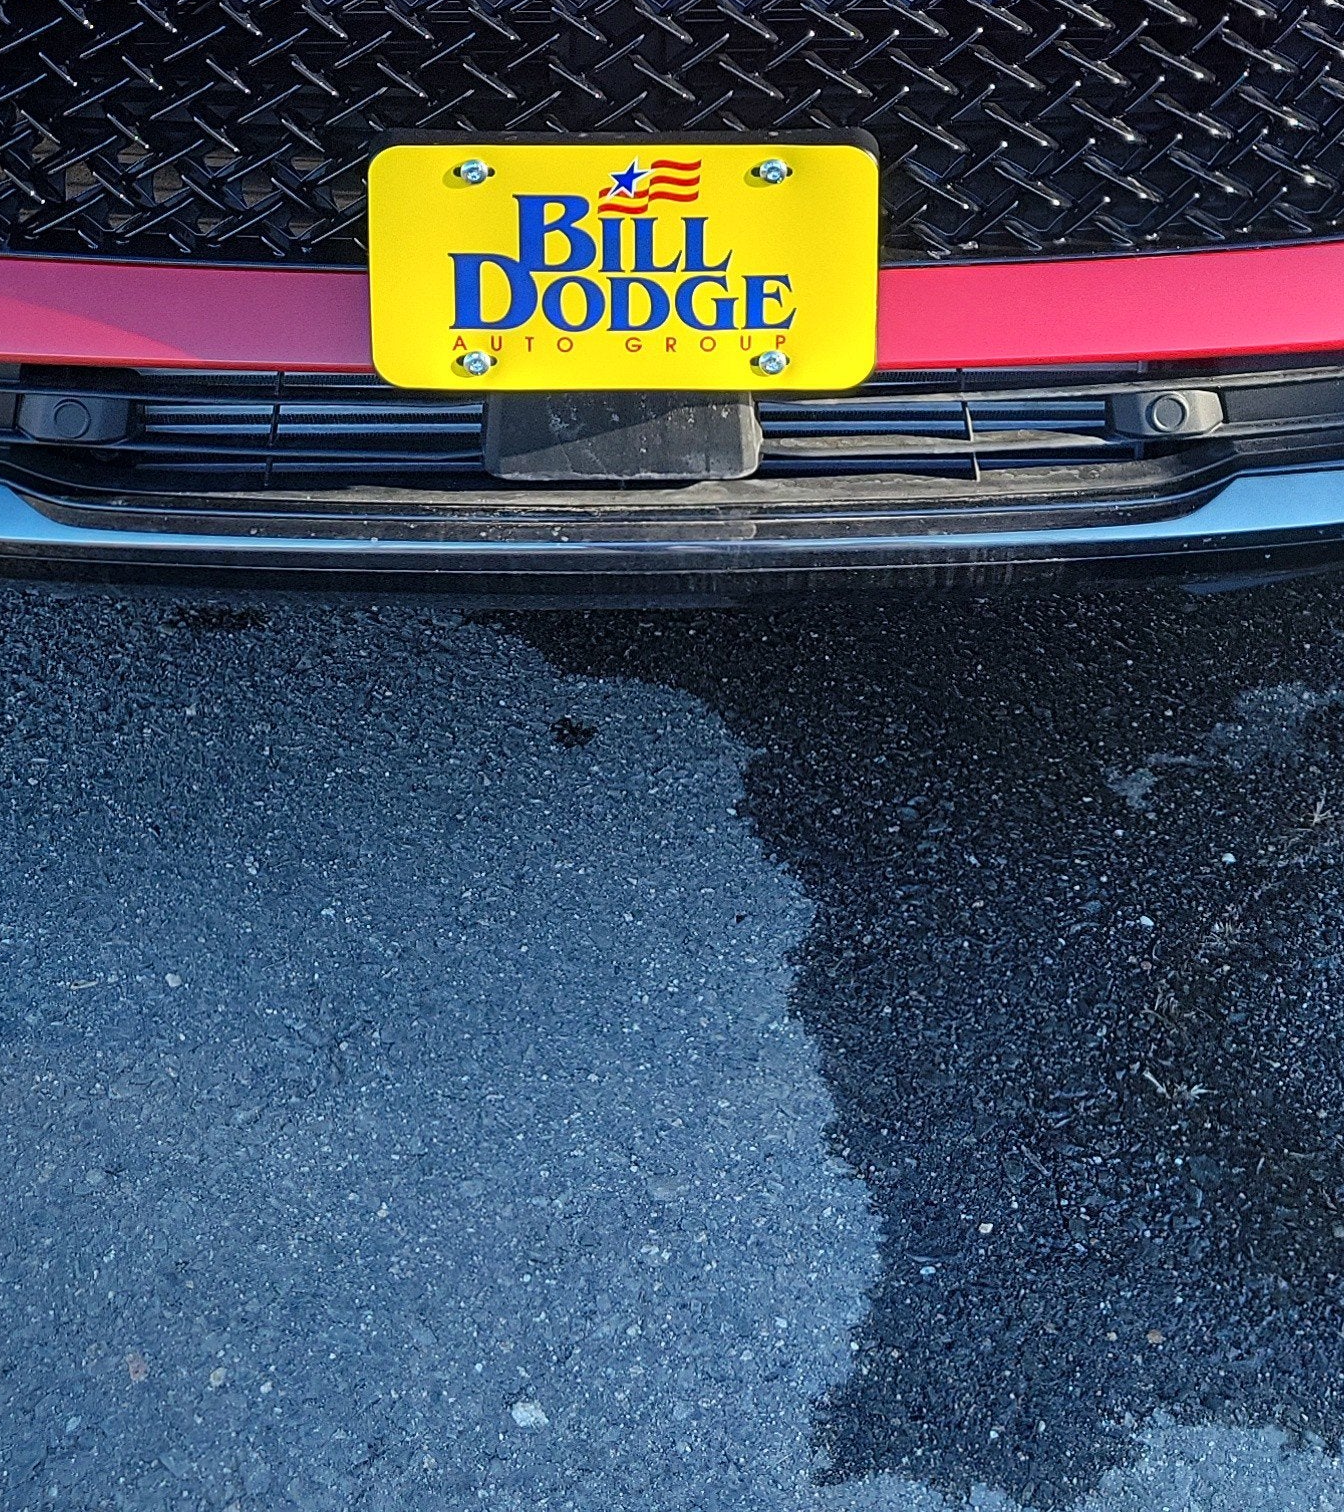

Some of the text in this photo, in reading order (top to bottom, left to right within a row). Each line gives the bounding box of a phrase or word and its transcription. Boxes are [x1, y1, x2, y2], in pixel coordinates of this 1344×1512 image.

[512, 194, 733, 273] BILL
[448, 252, 797, 332] DODGE
[452, 334, 787, 353] AUTO GROUP
